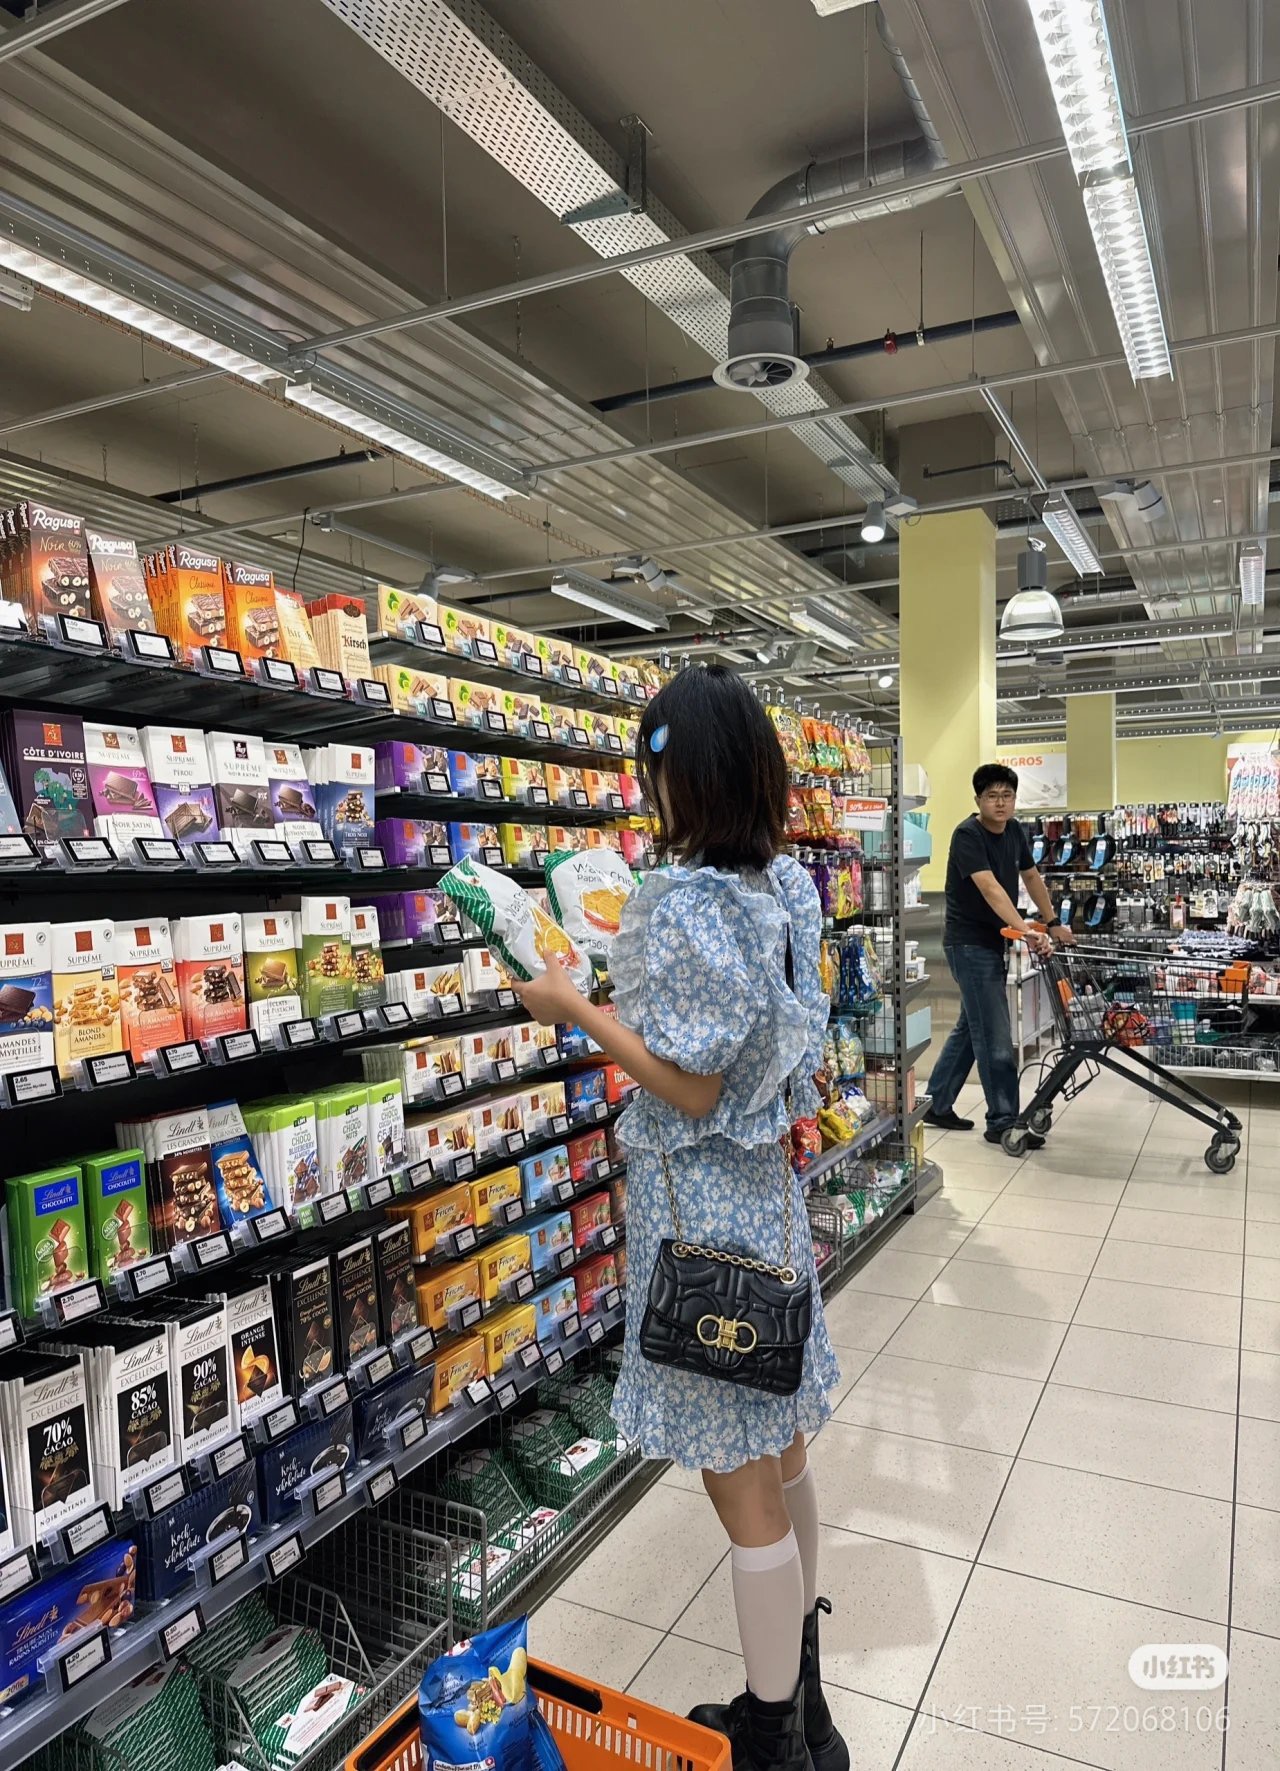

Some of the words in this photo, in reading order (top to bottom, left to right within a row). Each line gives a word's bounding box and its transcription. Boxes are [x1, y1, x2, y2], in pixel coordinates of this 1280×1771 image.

[32, 509, 81, 532] Ragusa
[40, 536, 65, 551] Noir
[89, 534, 133, 554] Ragusa
[179, 551, 217, 570] Ragusa
[235, 567, 270, 585] Ragusa
[341, 634, 367, 650] Kirsch
[23, 746, 46, 757] CÔTE
[48, 749, 84, 760] D'IVOIRE
[223, 761, 262, 772] SUPRÊME
[112, 820, 131, 828] NOIR
[129, 948, 160, 957] SUPRÊME
[203, 943, 231, 954] SUPRÊME
[0, 956, 34, 968] UPRÊME
[67, 953, 102, 965] SUPRÊME
[74, 1032, 106, 1043] AMANDES
[78, 1027, 101, 1037] BLOND
[0, 1045, 41, 1057] MYRTILLES
[167, 1120, 197, 1137] Lindt
[343, 1120, 361, 1134] CHOCO
[167, 1140, 177, 1150] LES
[178, 1135, 207, 1149] GRANDES
[291, 1133, 312, 1146] CHOCO
[108, 1167, 130, 1182] Lindt
[44, 1184, 66, 1200] Lindt
[108, 1177, 136, 1191] CHOCOLETTI
[42, 1196, 73, 1210] CHOCOLETTI
[384, 1235, 403, 1253] Lindt
[343, 1252, 365, 1274] Lindt
[382, 1247, 410, 1266] EXCELLENCE
[135, 1269, 147, 1278] 2.70
[342, 1266, 372, 1285] EXCELLENCE
[297, 1273, 322, 1296] Lindt
[62, 1295, 75, 1304] 2.70
[233, 1294, 260, 1318] Lindt
[297, 1288, 329, 1308] EXCELLENCE
[233, 1307, 269, 1329] EXCELLENCE
[313, 1307, 329, 1318] COCOA
[184, 1320, 215, 1347] Lindt
[240, 1324, 265, 1340] ORANGE
[241, 1331, 266, 1347] INTENSE
[184, 1335, 224, 1360] EXCELLENCE
[120, 1346, 153, 1373] Lindt
[120, 1361, 164, 1388] EXCELLENCE
[193, 1355, 217, 1384] 90%
[32, 1376, 68, 1404] Lindt
[194, 1373, 217, 1391] CACAO
[131, 1382, 157, 1411] 85%
[30, 1393, 80, 1421] EXCELLENCE
[131, 1400, 158, 1420] CACAO
[42, 1416, 73, 1448] 70%
[43, 1436, 74, 1457] CACAO
[186, 1438, 200, 1450] NOIR
[123, 1470, 140, 1484] NOIR
[141, 1456, 169, 1477] PUISSANT
[151, 1485, 162, 1495] 3.20
[40, 1513, 58, 1526] NOIR
[60, 1497, 87, 1516] INTENSE
[70, 1525, 82, 1536] 3.20
[170, 1523, 194, 1548] Koch-
[12, 1611, 51, 1647] Lindt
[66, 1653, 80, 1665] 4.20
